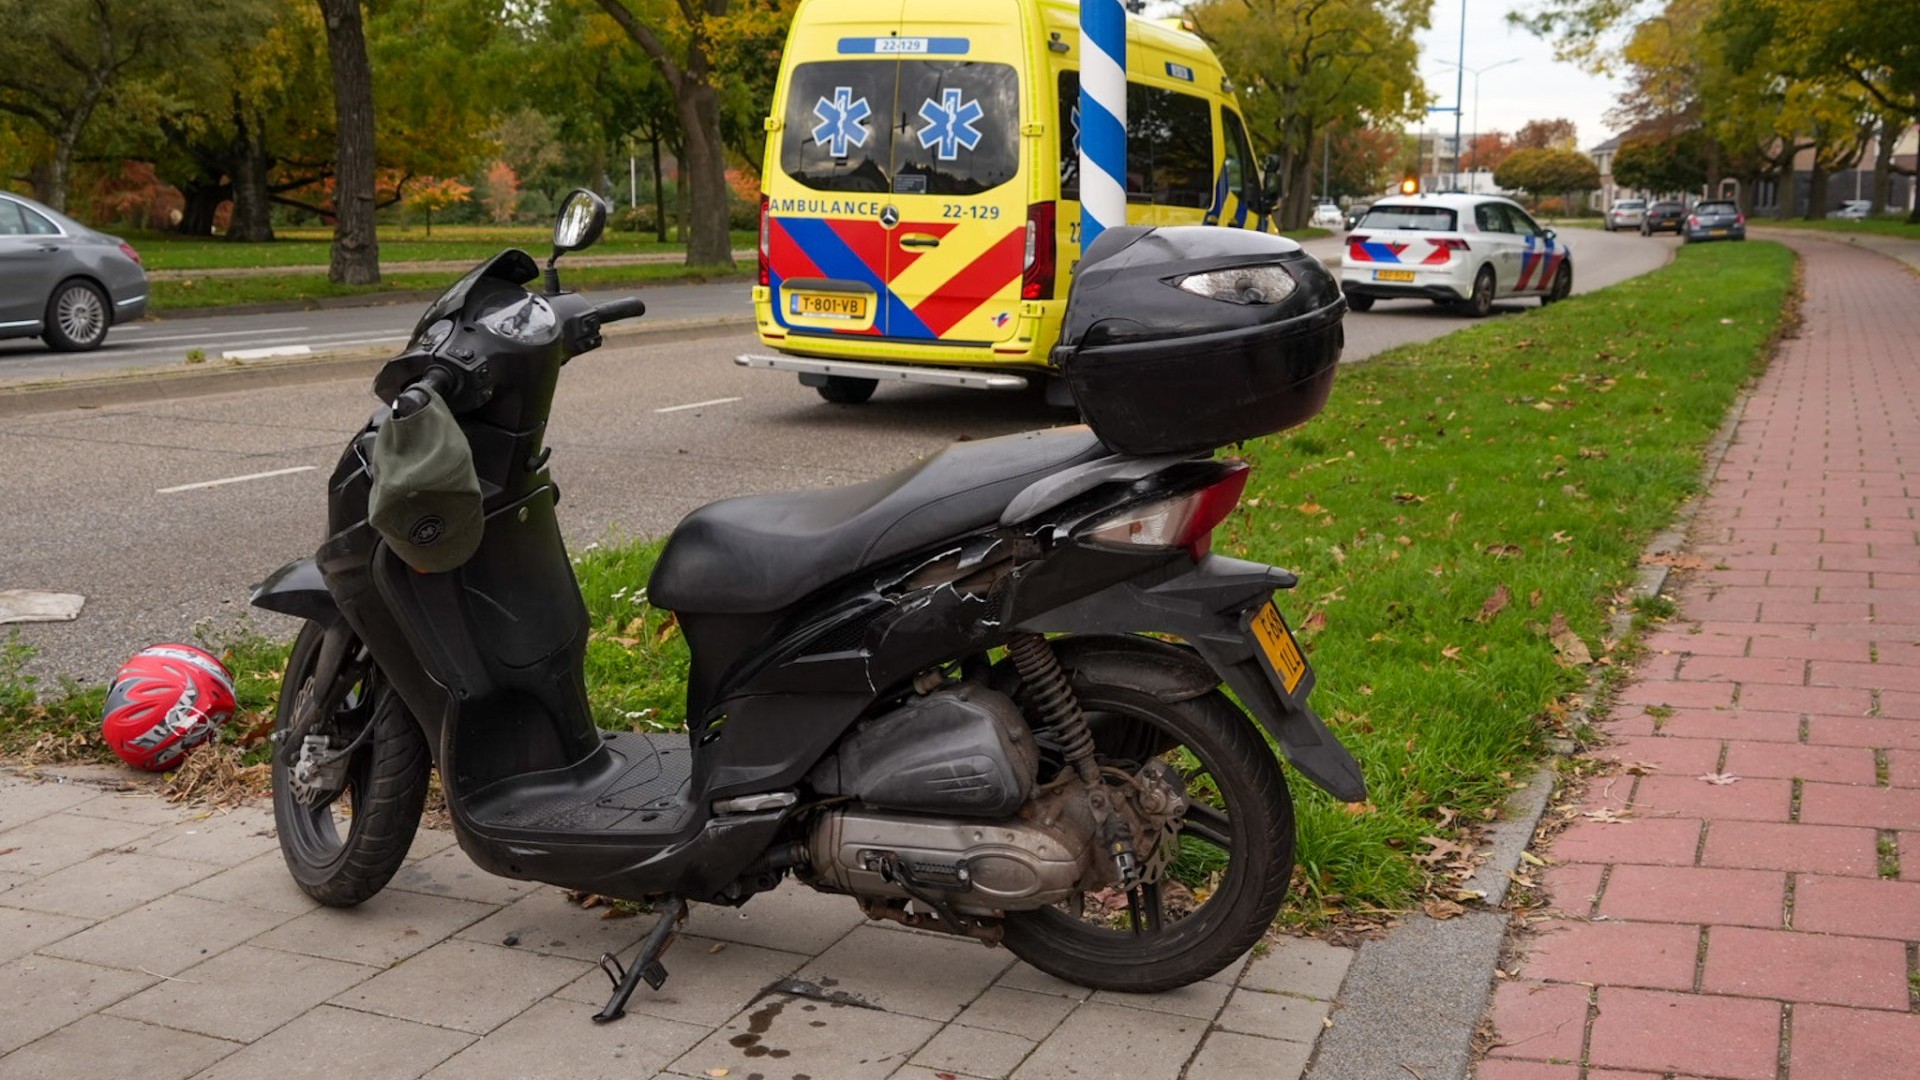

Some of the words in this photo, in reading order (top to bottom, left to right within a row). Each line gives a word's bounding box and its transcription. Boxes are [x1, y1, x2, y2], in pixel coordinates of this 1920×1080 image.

[882, 40, 921, 51] 22-129
[769, 198, 879, 216] AMBULANCE
[942, 204, 1000, 220] 22-129
[803, 296, 858, 314] T-801-VB
